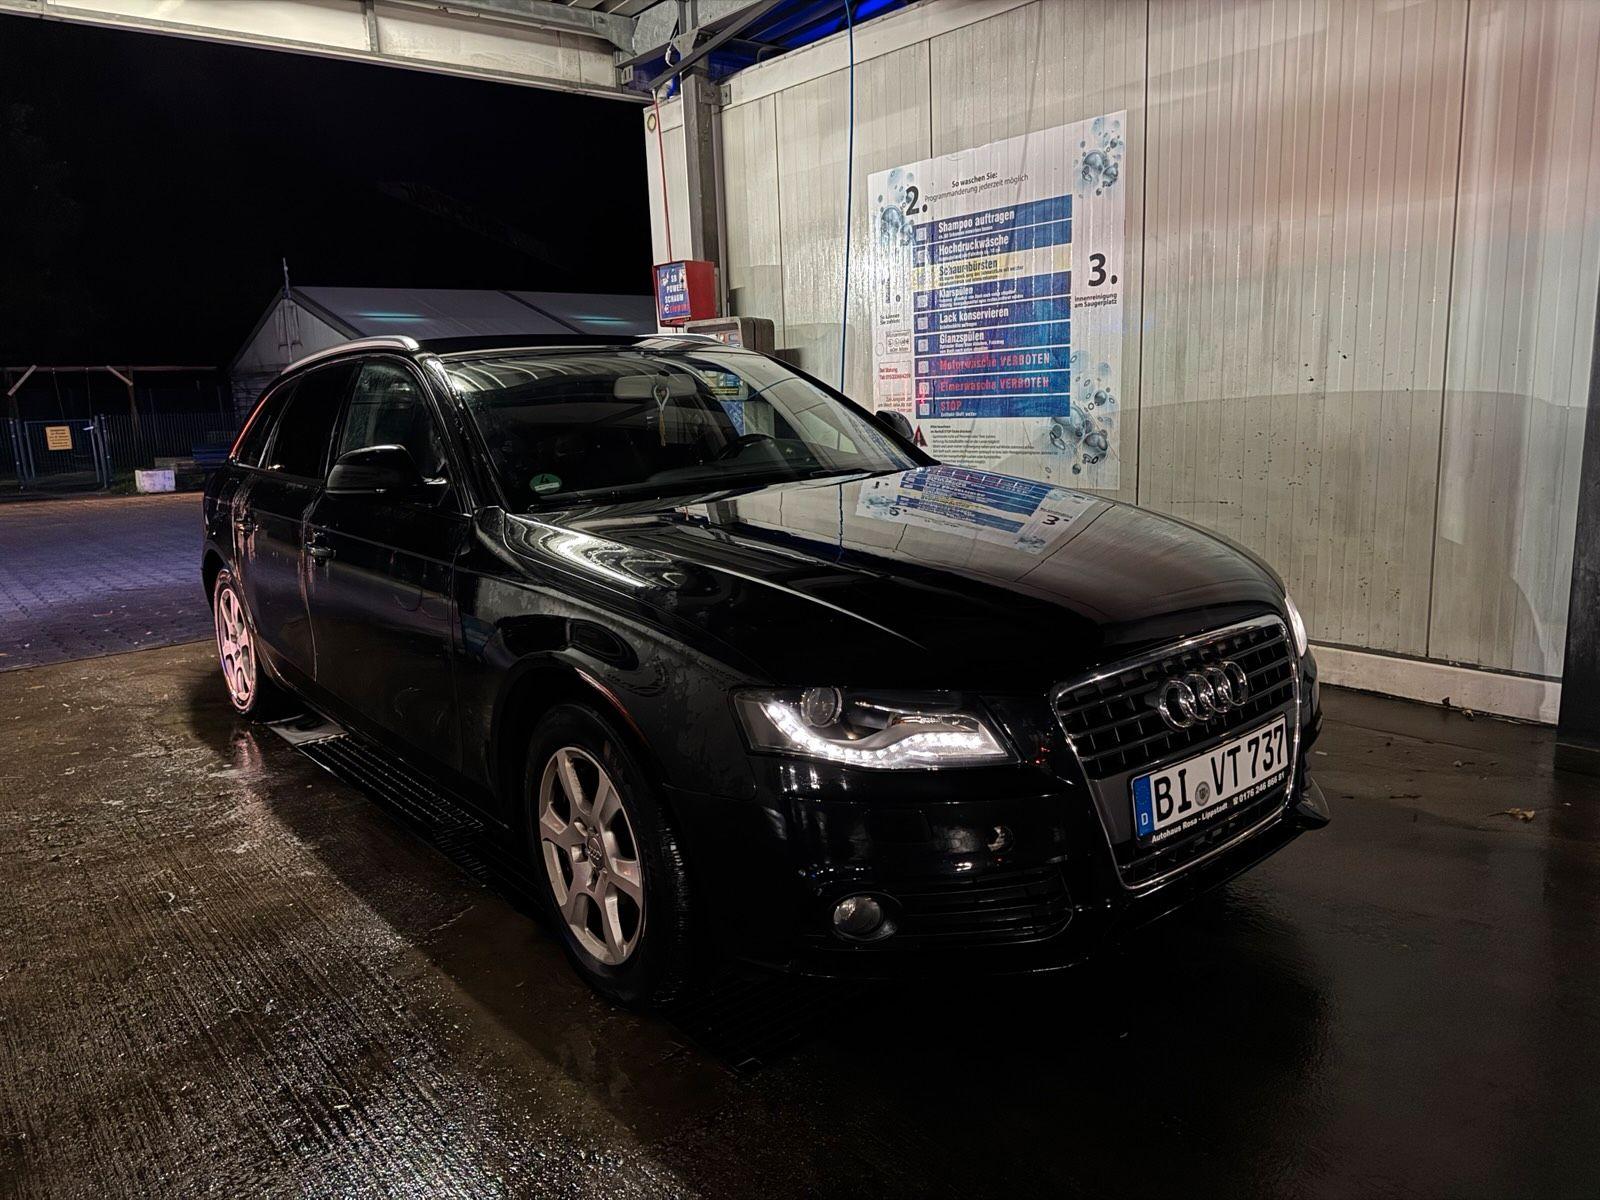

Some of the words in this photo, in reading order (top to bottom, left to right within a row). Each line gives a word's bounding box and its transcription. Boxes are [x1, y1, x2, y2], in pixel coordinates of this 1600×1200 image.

[952, 180, 959, 188] So
[960, 175, 985, 186] waschen
[986, 172, 998, 180] Sie:
[979, 180, 1003, 192] jederzeit
[905, 185, 928, 216] 2.
[938, 218, 973, 234] Shampoo
[974, 210, 1015, 227] auftragen
[1088, 253, 1118, 287] 3.
[940, 312, 957, 324] Lack
[959, 307, 1009, 322] konservieren
[939, 331, 985, 345] Glanzspülen
[1000, 352, 1050, 368] VERBOTEN
[1000, 376, 1050, 390] VERBOTEN
[940, 400, 962, 412] STOP
[1154, 768, 1192, 822] BI
[1210, 745, 1241, 796] VT
[1247, 723, 1284, 779] 737
[1140, 812, 1149, 826] D
[1152, 826, 1182, 844] Autohaus
[1182, 818, 1198, 830] Rosa
[1201, 802, 1228, 820] Lippstadt
